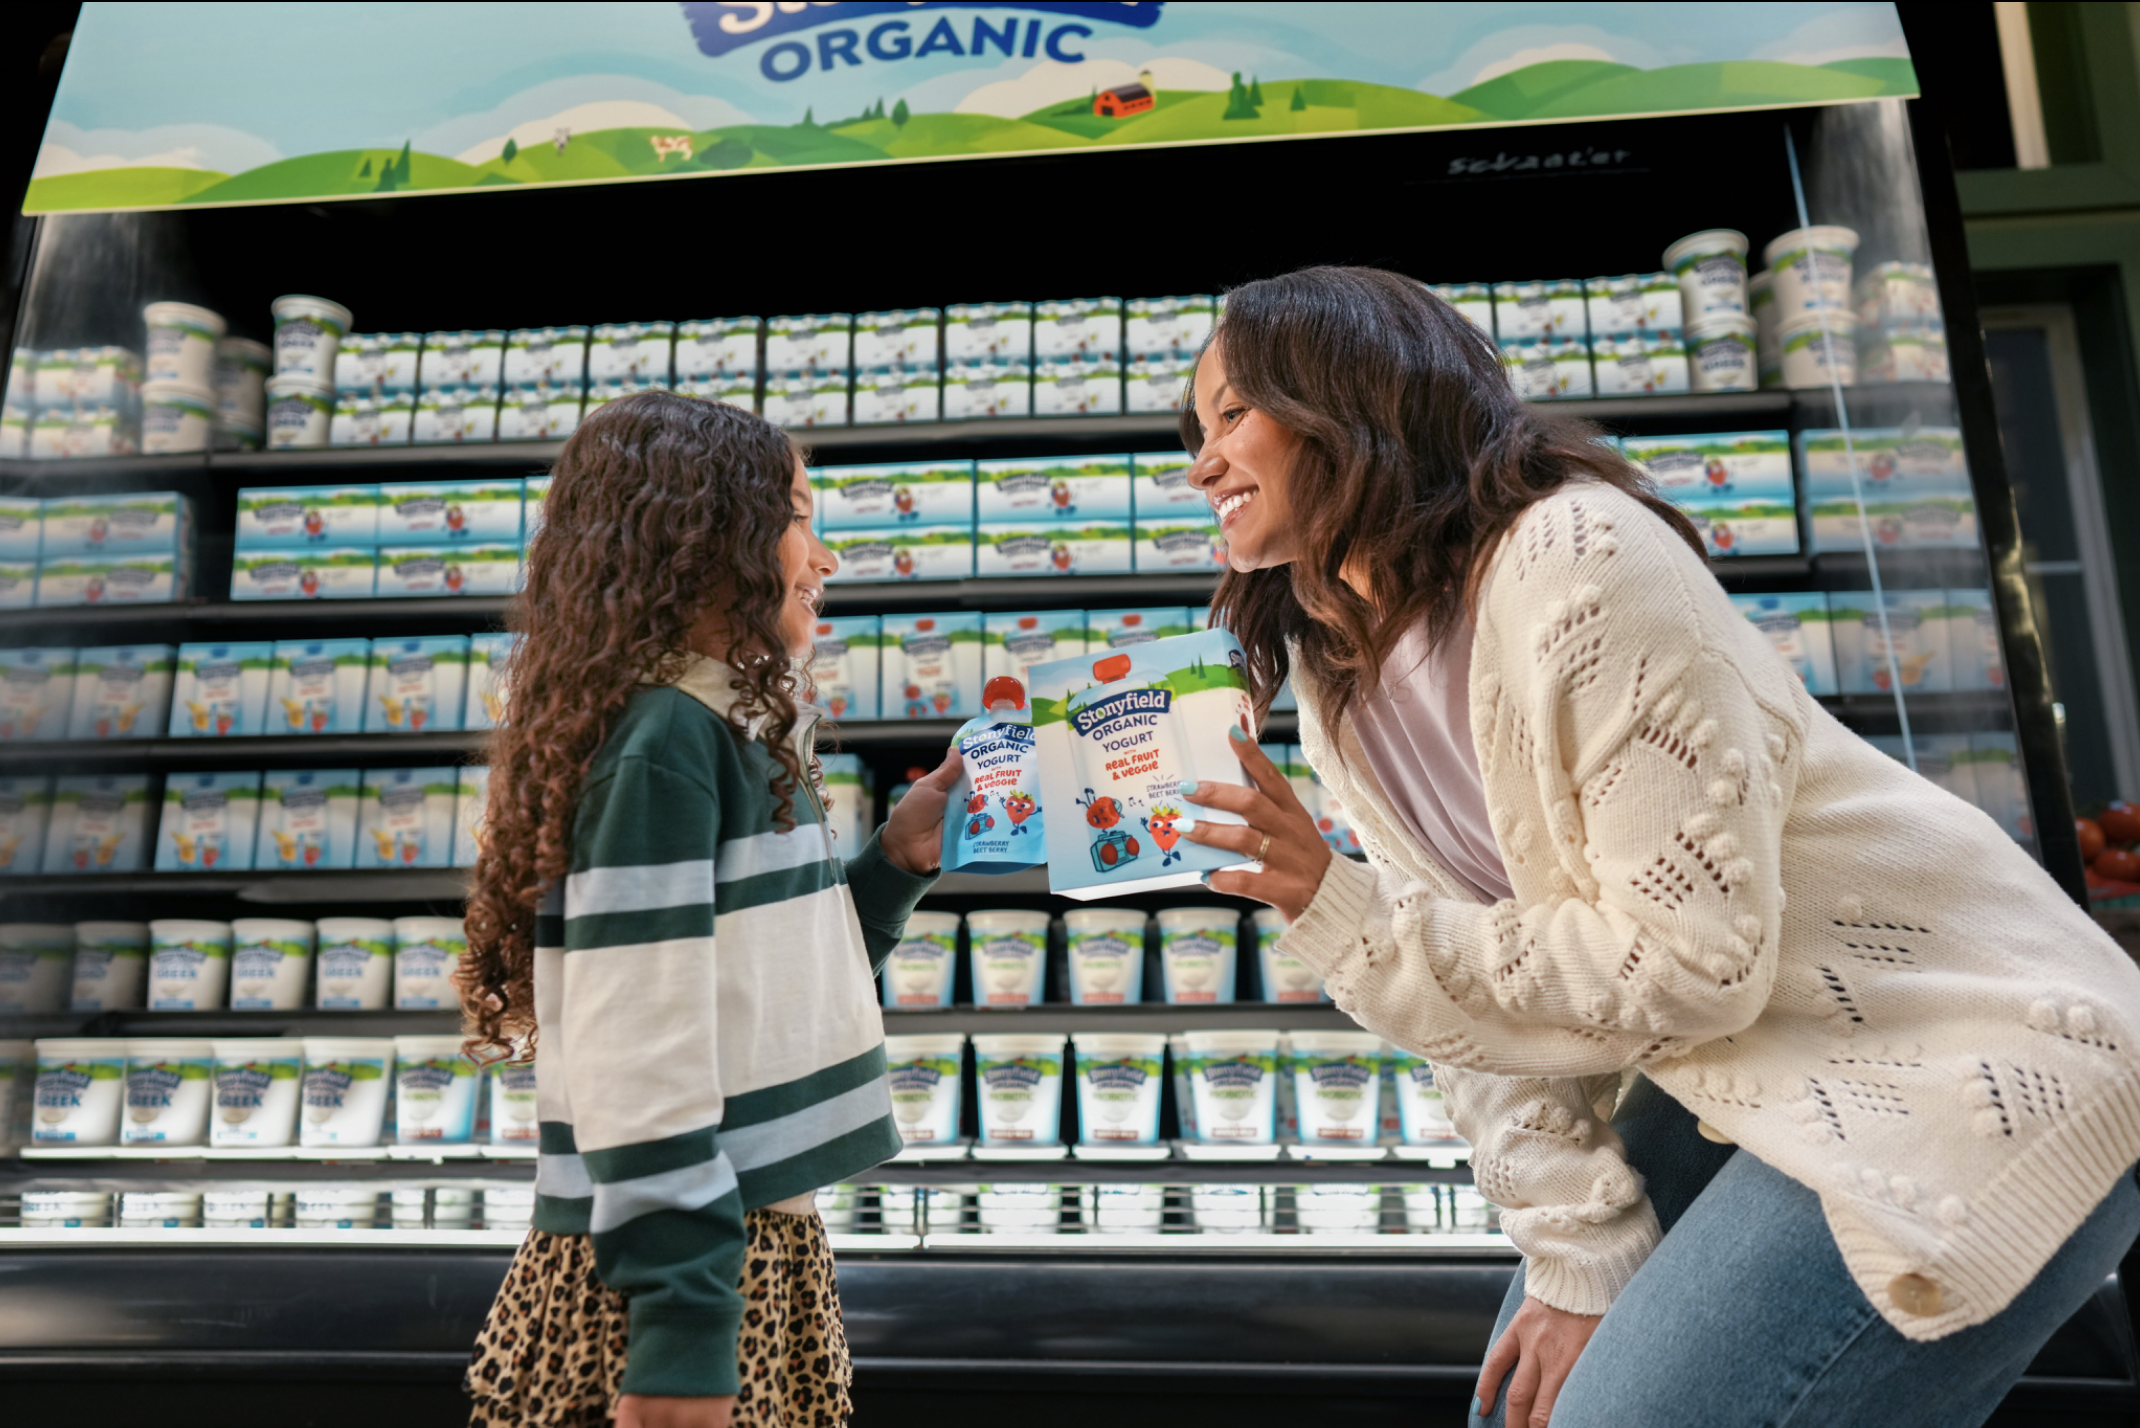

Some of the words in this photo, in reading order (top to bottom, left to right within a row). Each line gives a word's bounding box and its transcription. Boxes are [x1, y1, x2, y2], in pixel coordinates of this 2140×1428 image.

[760, 16, 1093, 83] ORGANIC
[1078, 691, 1165, 731] Stonyfield
[1093, 714, 1158, 741] ORGANIC
[1102, 730, 1154, 753] YOGURT
[970, 741, 1029, 760] ORGANIC
[1132, 749, 1160, 763] FRUIT
[977, 754, 1022, 770] YOGURT
[995, 769, 1022, 779] FRUIT
[1112, 772, 1121, 781] &
[977, 784, 983, 792] &
